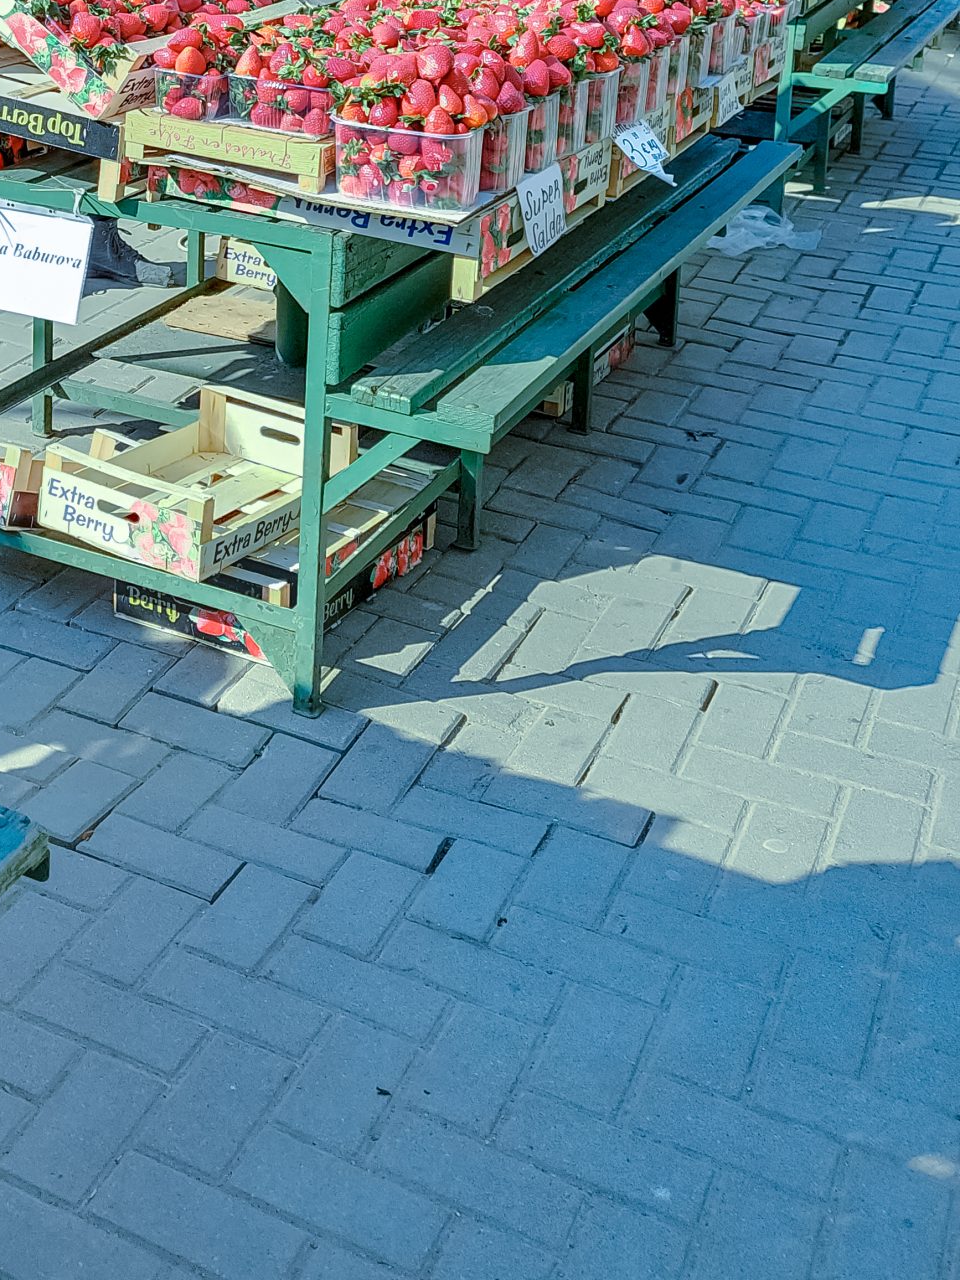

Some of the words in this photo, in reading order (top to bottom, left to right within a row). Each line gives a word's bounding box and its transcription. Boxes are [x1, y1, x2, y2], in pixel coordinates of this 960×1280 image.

[48, 115, 86, 147] Top
[584, 149, 604, 170] Berry
[589, 165, 608, 187] Extra
[381, 215, 454, 247] Extra
[13, 243, 83, 270] Baburova
[223, 247, 261, 268] Extra
[235, 265, 276, 287] Berry
[48, 478, 96, 510] Extra
[62, 505, 115, 542] Berry
[212, 532, 253, 565] Extra
[255, 513, 293, 542] Berry
[127, 585, 180, 623] Berry
[323, 587, 353, 623] Berry
